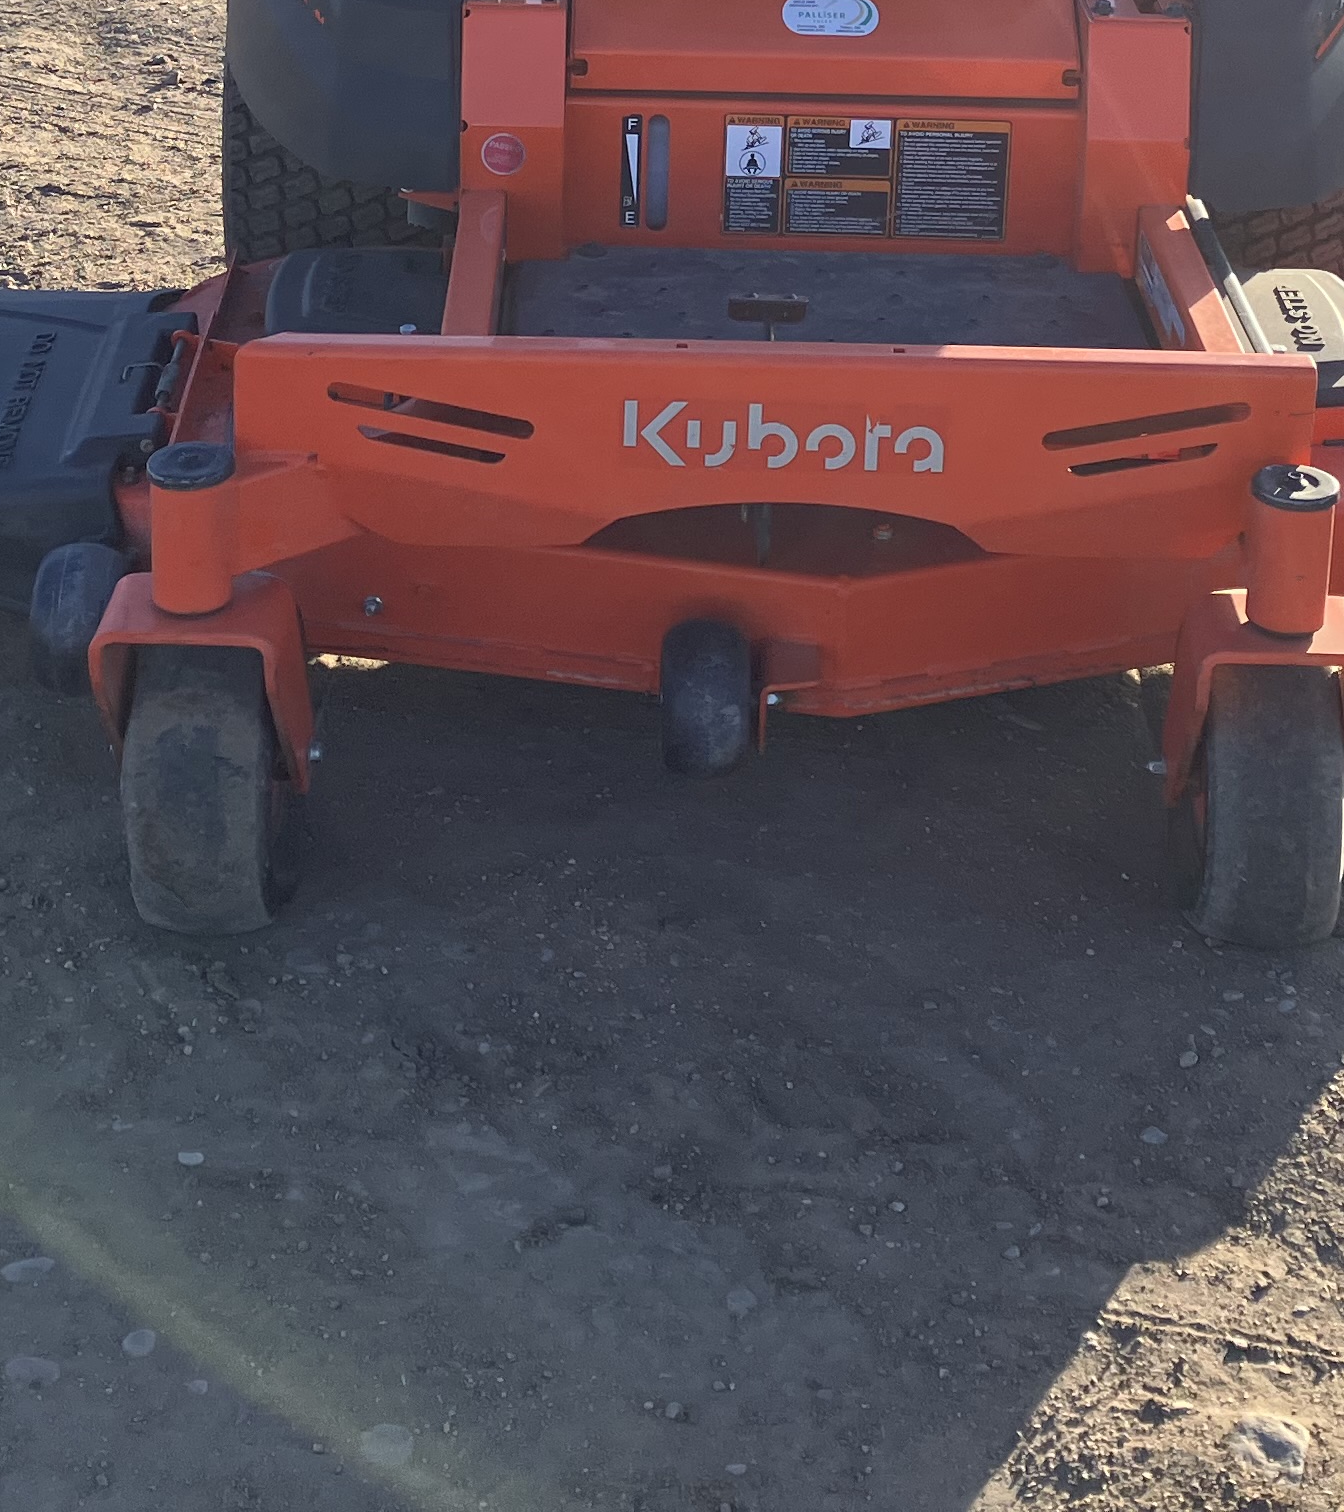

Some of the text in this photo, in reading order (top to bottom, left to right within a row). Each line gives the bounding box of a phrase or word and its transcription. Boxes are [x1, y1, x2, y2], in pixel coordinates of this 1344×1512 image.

[627, 118, 638, 131] F
[802, 118, 846, 127] WARNING
[625, 211, 635, 224] E
[1273, 285, 1313, 324] STE
[623, 399, 945, 473] Kubota
